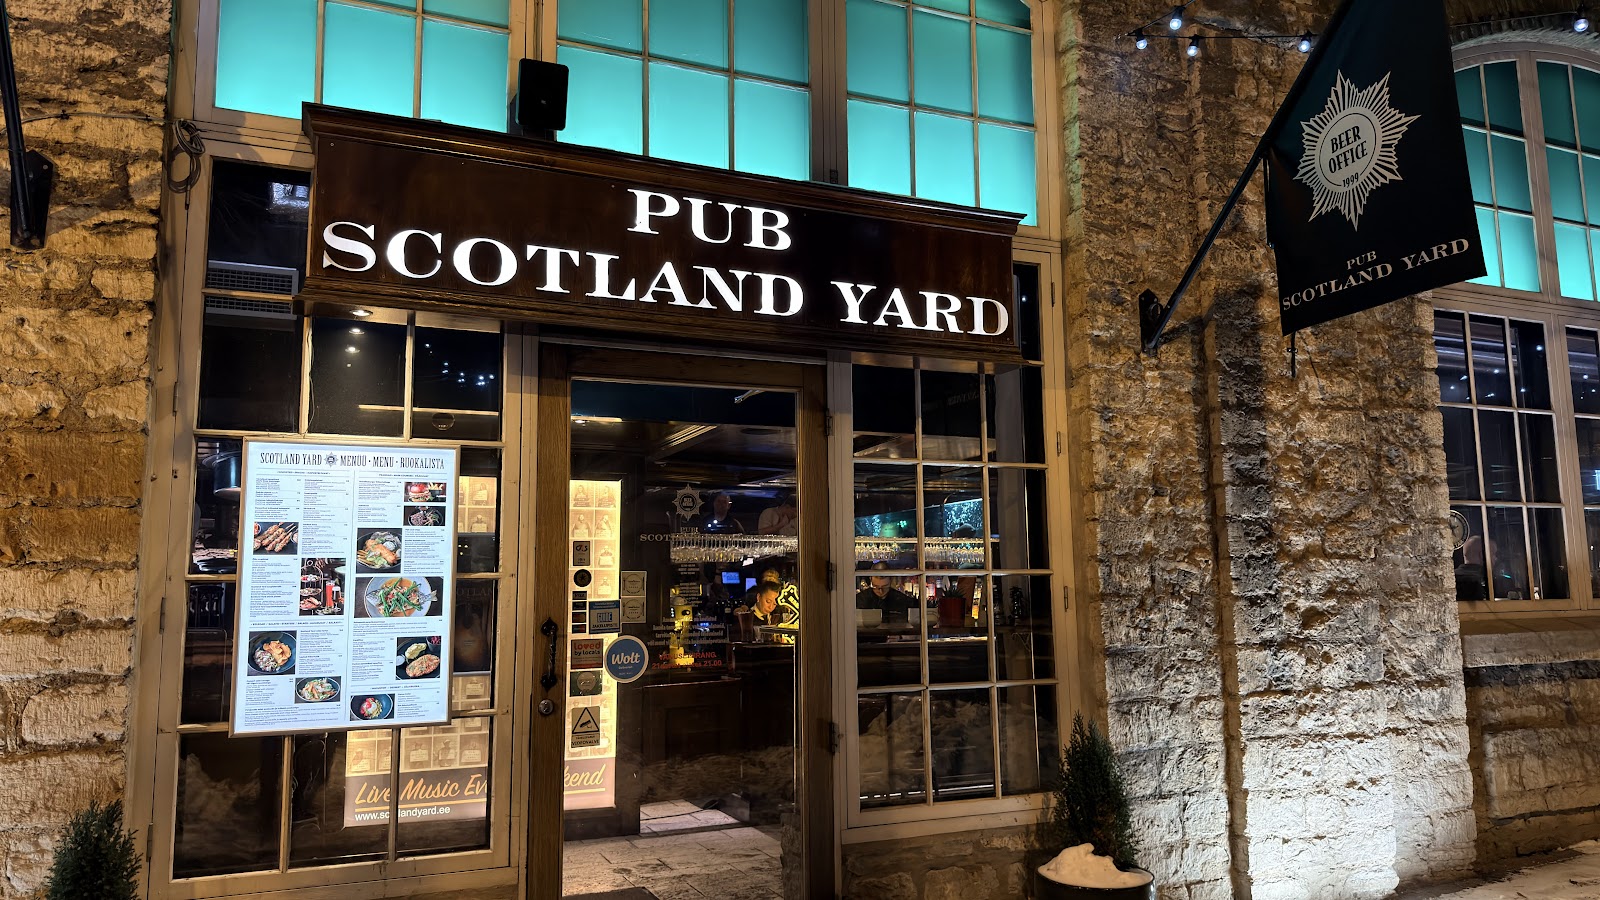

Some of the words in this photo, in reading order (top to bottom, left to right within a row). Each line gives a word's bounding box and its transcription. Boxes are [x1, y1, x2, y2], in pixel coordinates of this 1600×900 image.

[1330, 125, 1362, 153] BEER
[1328, 140, 1368, 174] OFFICE
[1342, 172, 1360, 188] 1999
[627, 189, 791, 250] PUB
[1346, 250, 1377, 270] PUB
[323, 222, 803, 316] SCOTLAND
[831, 281, 1008, 335] YARD
[1282, 262, 1393, 311] SCOTLAND
[1400, 238, 1470, 271] YARD
[260, 452, 301, 465] SCOTLAND
[302, 453, 323, 466] YARD
[372, 456, 394, 468] MENU
[400, 457, 445, 469] RUOKALISTA
[611, 652, 641, 665] Wolt
[354, 781, 391, 805] Live
[400, 777, 460, 801] Music
[354, 804, 451, 822] www.sclandyard.ee
